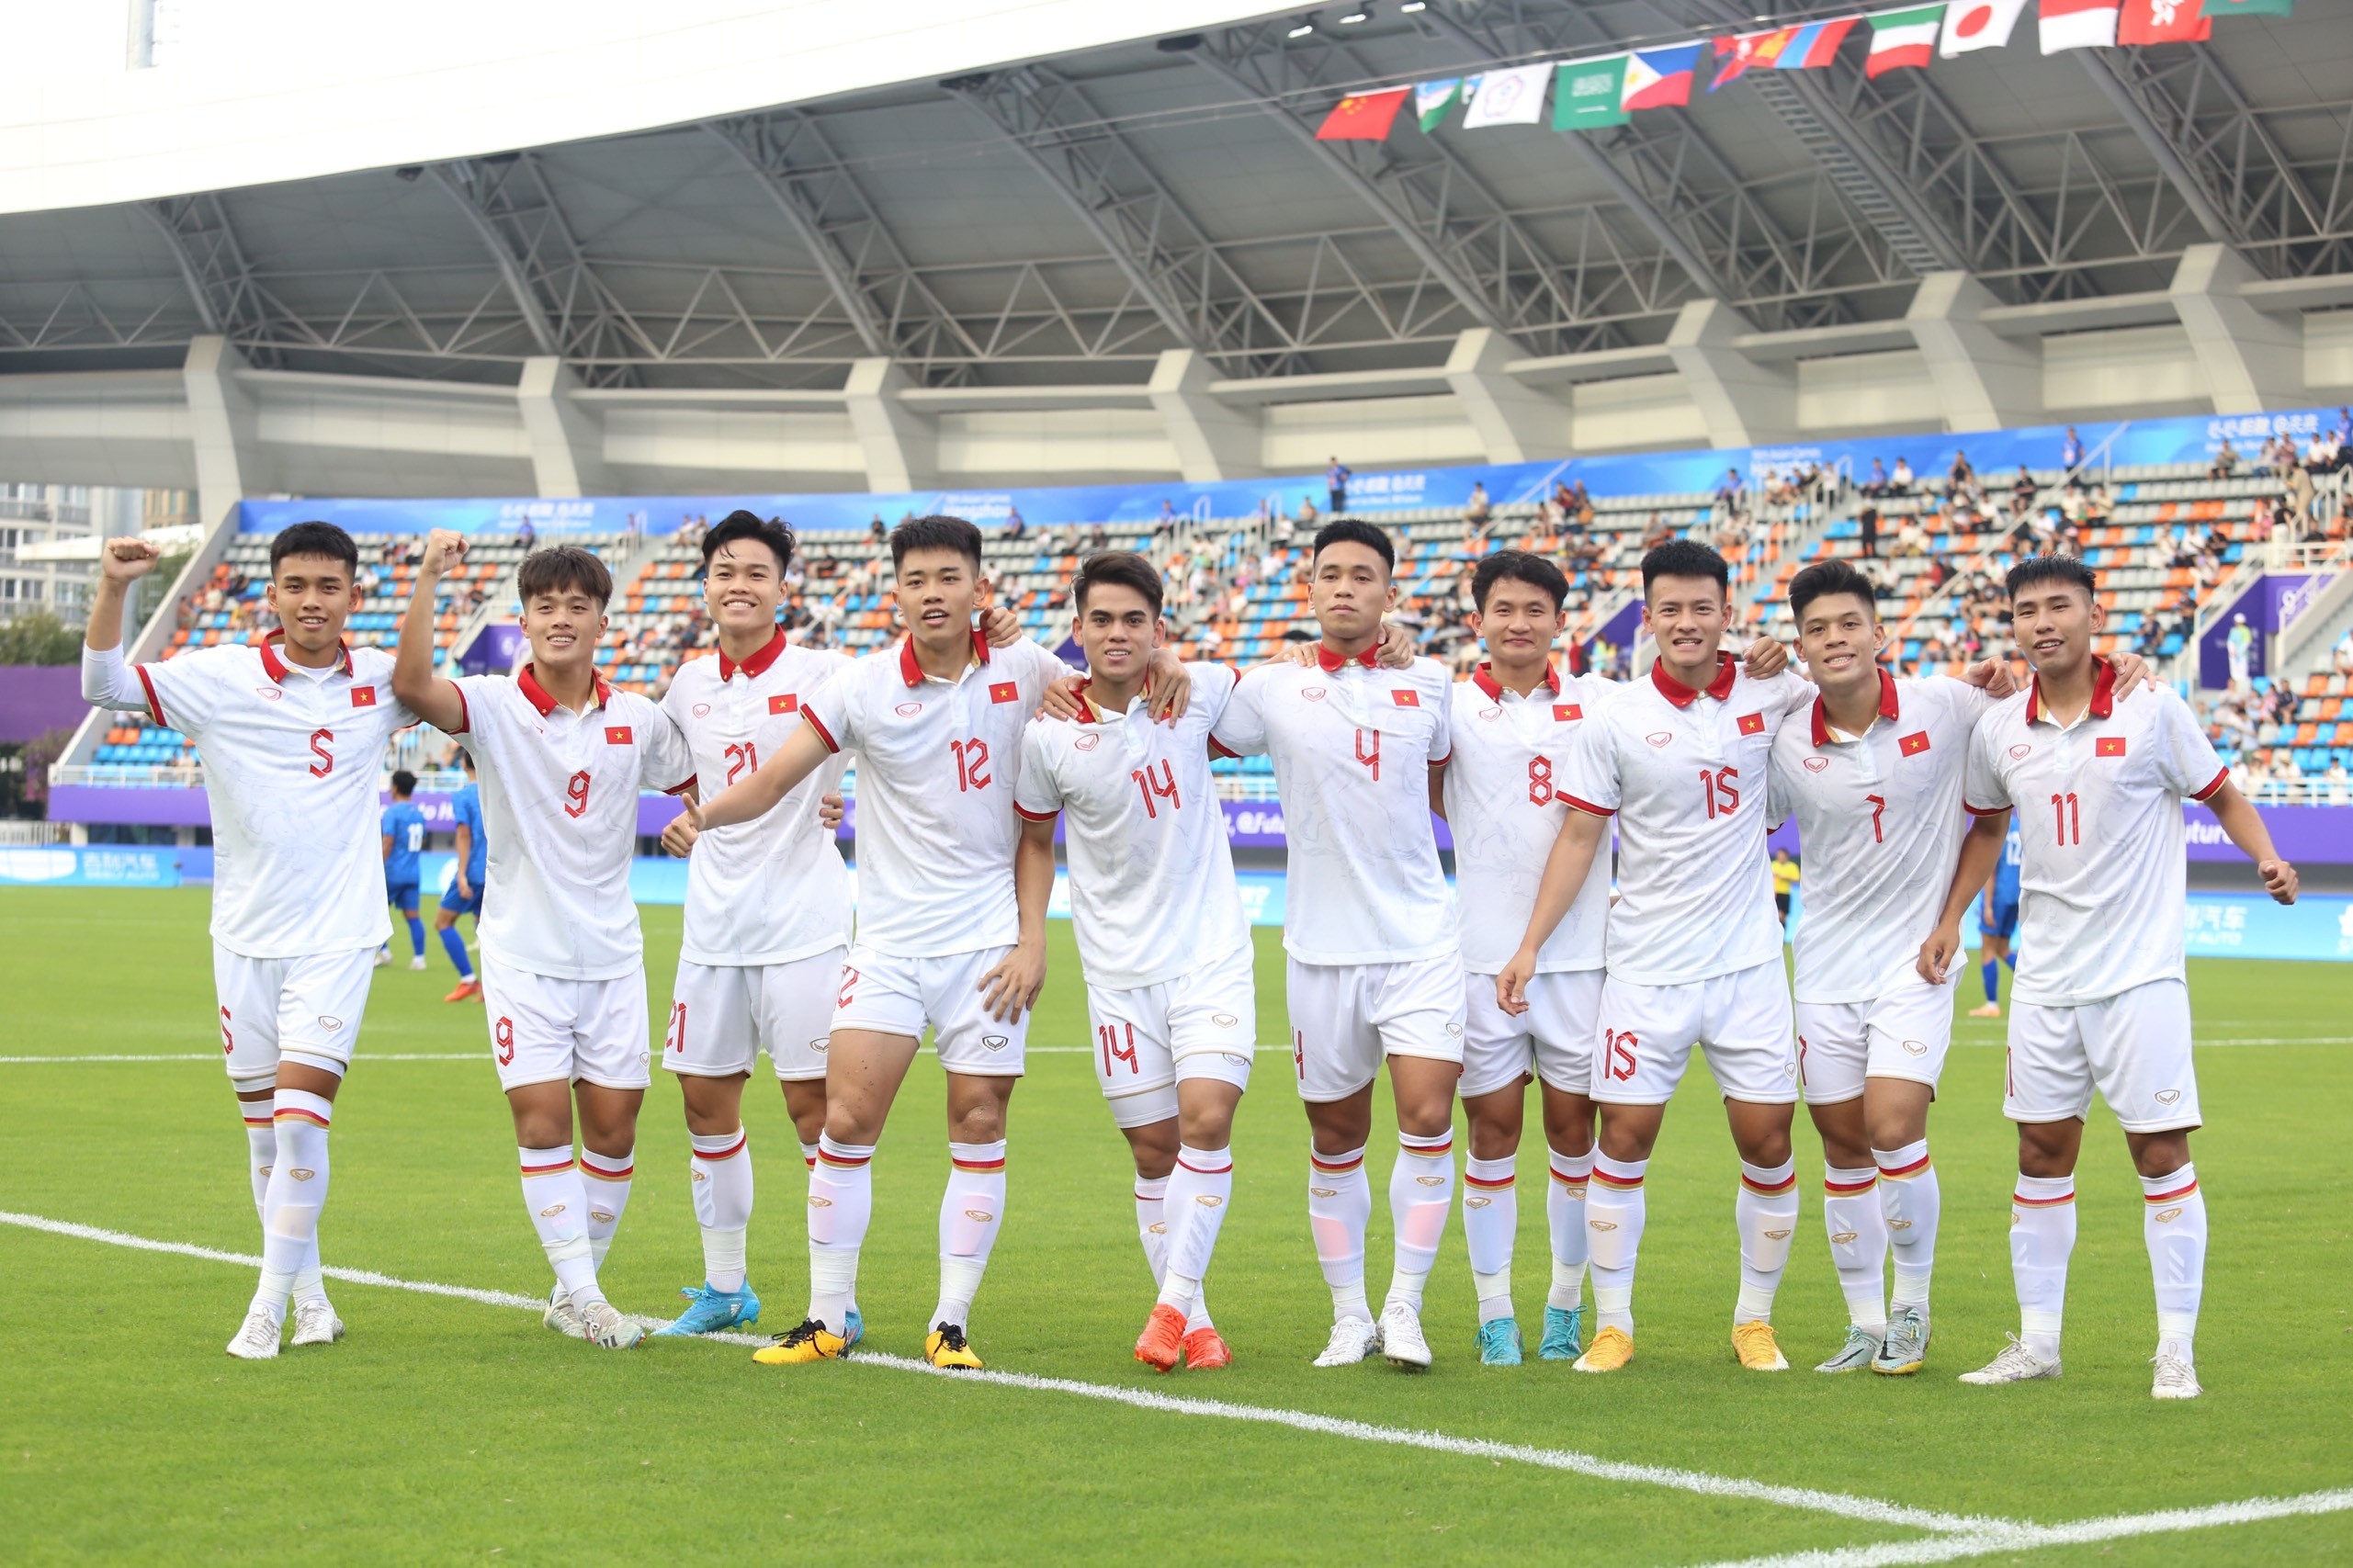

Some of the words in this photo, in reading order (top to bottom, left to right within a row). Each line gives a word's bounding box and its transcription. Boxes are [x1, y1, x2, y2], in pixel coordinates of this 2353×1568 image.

[311, 728, 334, 779] 5
[724, 741, 758, 786] 21
[950, 737, 992, 793] 12
[1354, 728, 1380, 782] 4
[564, 770, 592, 818] 9
[1131, 759, 1181, 818] 14
[1528, 754, 1553, 807] 8
[1699, 765, 1740, 819] 15
[1866, 793, 1885, 843] 7
[2051, 792, 2080, 847] 11
[838, 966, 860, 1009] 2
[496, 1016, 515, 1066] 9
[1099, 1022, 1139, 1077] 14
[1604, 1028, 1639, 1082] 15
